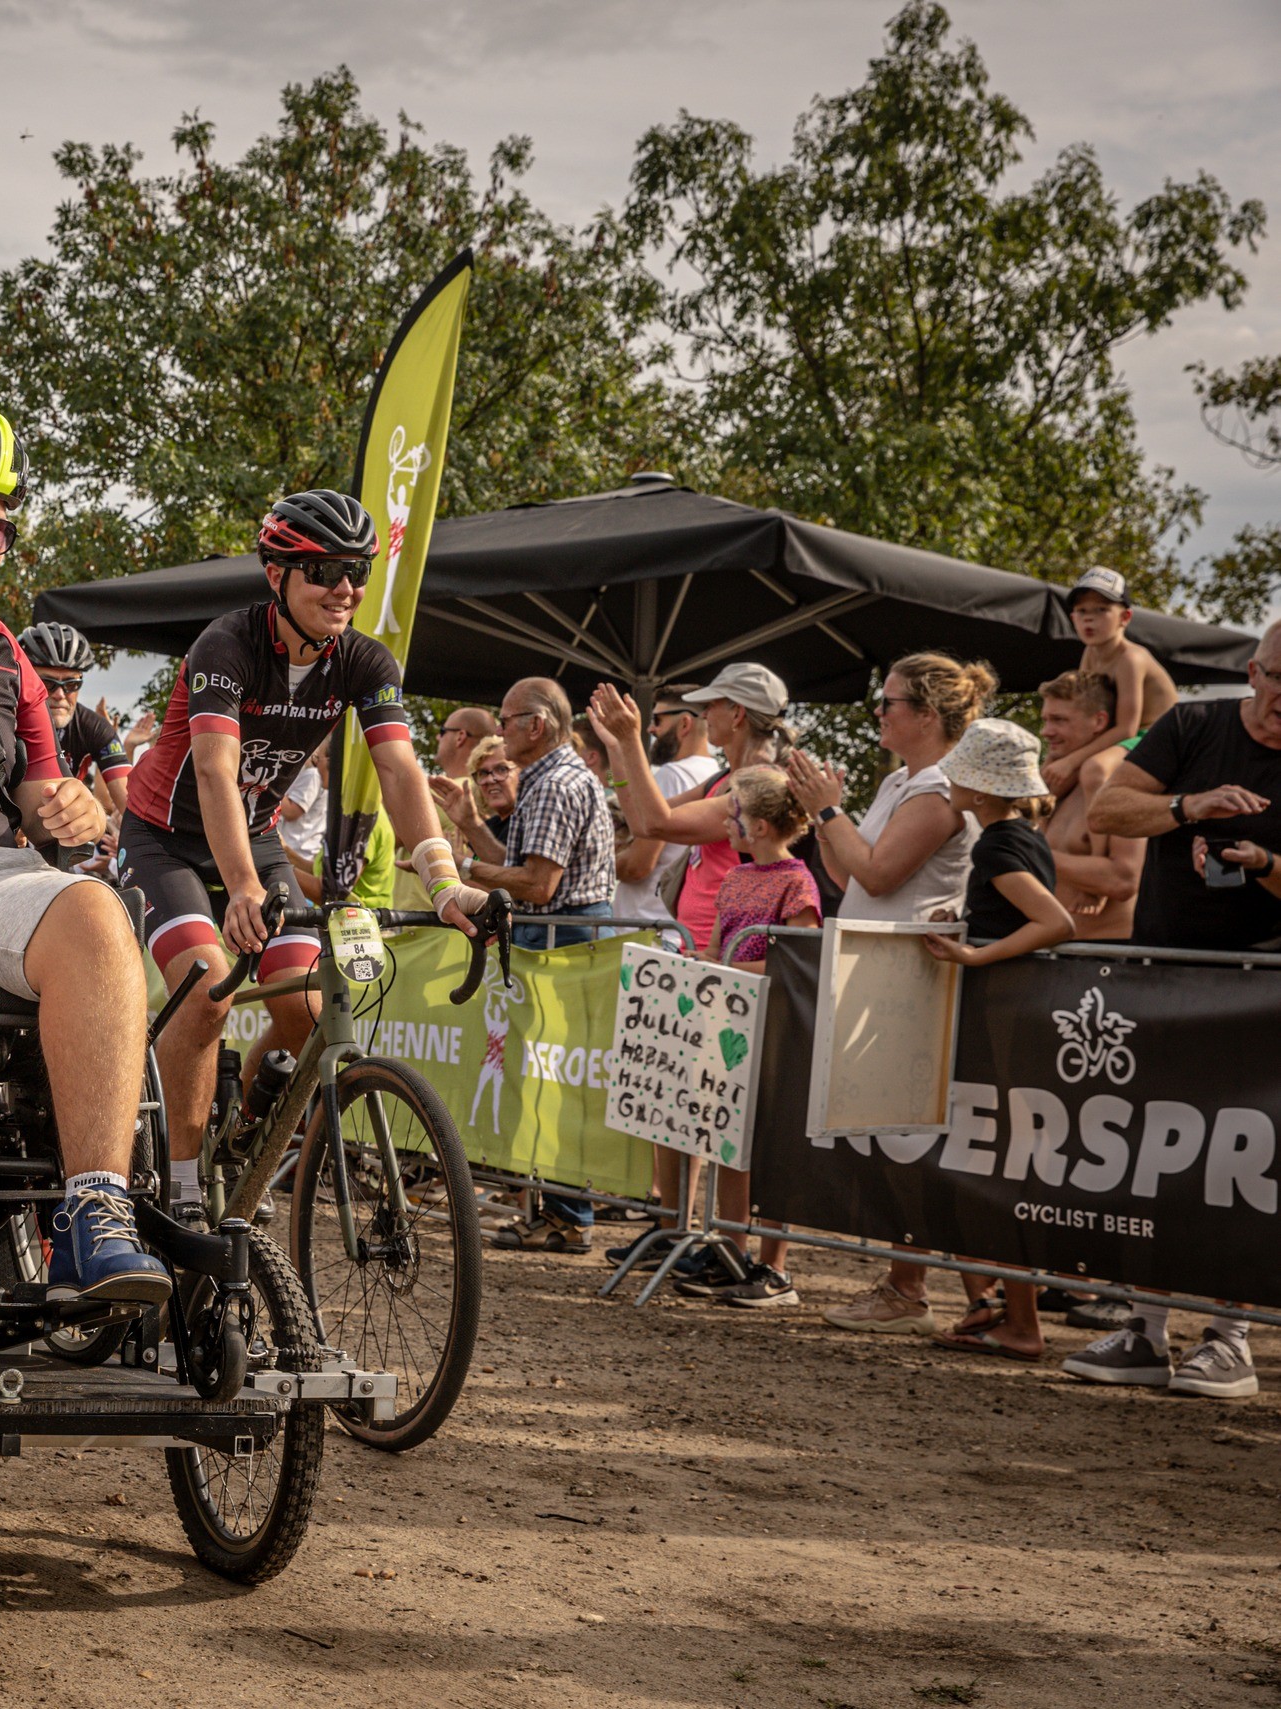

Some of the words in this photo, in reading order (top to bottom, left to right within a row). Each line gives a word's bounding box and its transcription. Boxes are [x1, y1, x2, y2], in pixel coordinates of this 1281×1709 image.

[353, 943, 365, 955] 84
[355, 1018, 463, 1065] UCHENNE
[1013, 1201, 1097, 1230] CYCLIST
[1103, 1213, 1155, 1239] BEER
